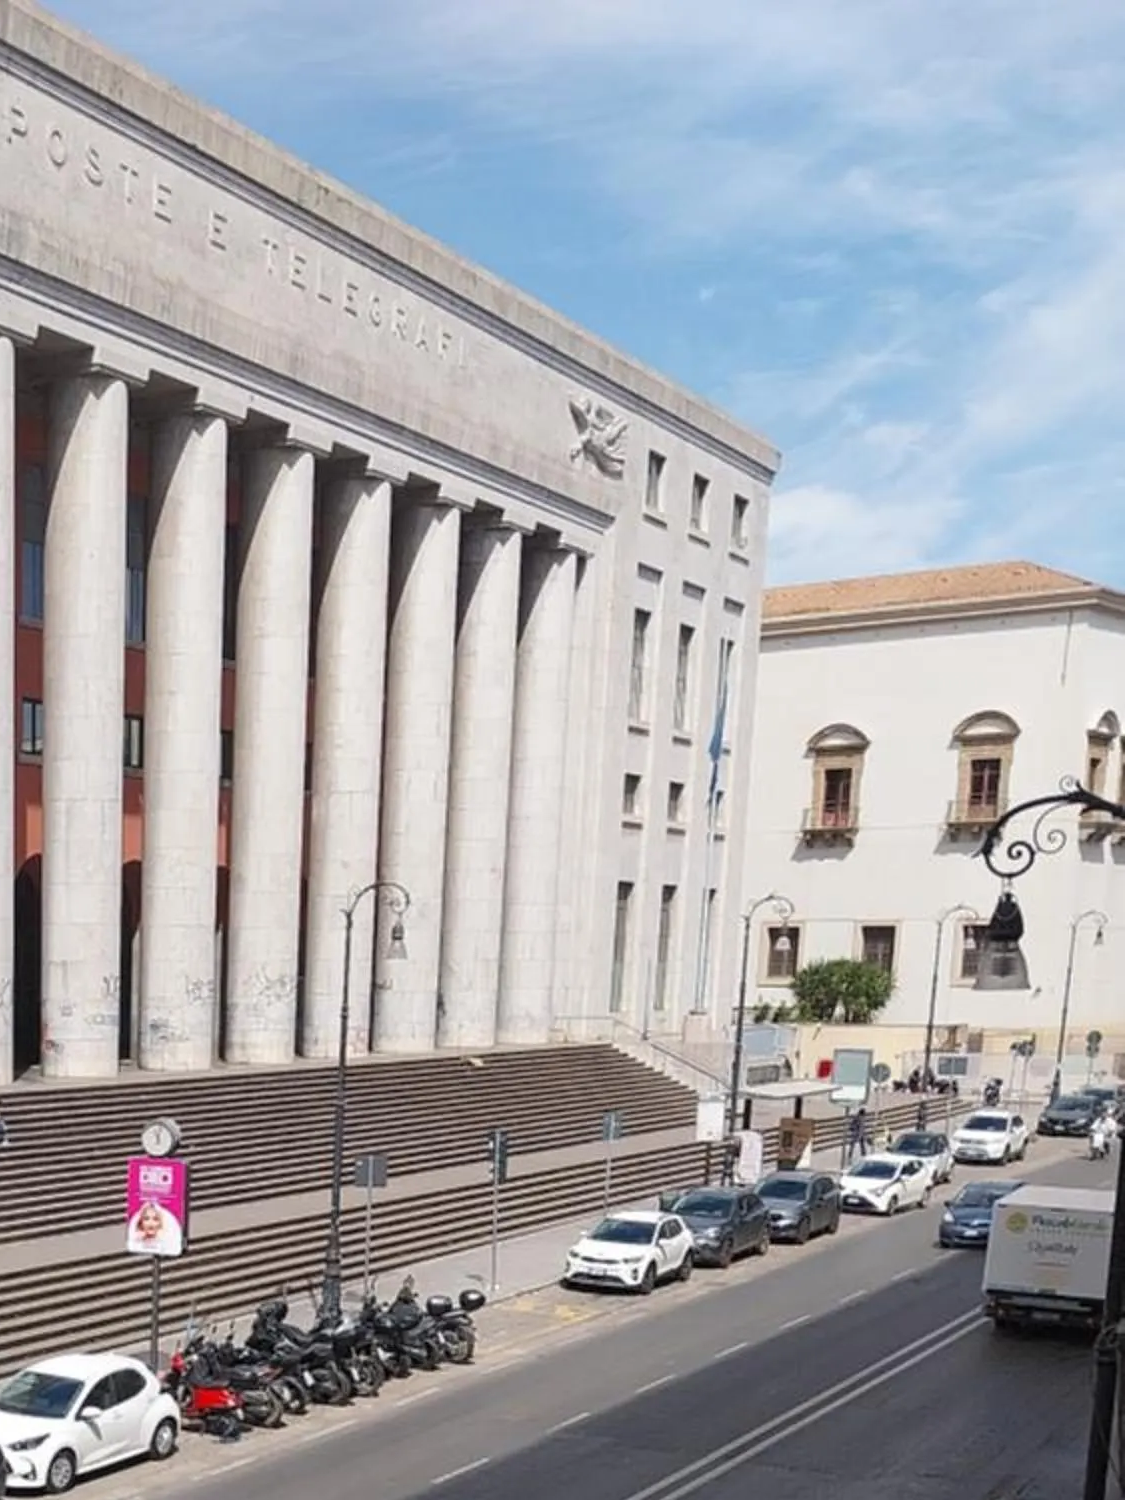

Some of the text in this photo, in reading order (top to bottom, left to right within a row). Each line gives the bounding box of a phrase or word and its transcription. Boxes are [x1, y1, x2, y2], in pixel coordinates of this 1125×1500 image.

[6, 103, 466, 367] POSTE E TELEGRAFI
